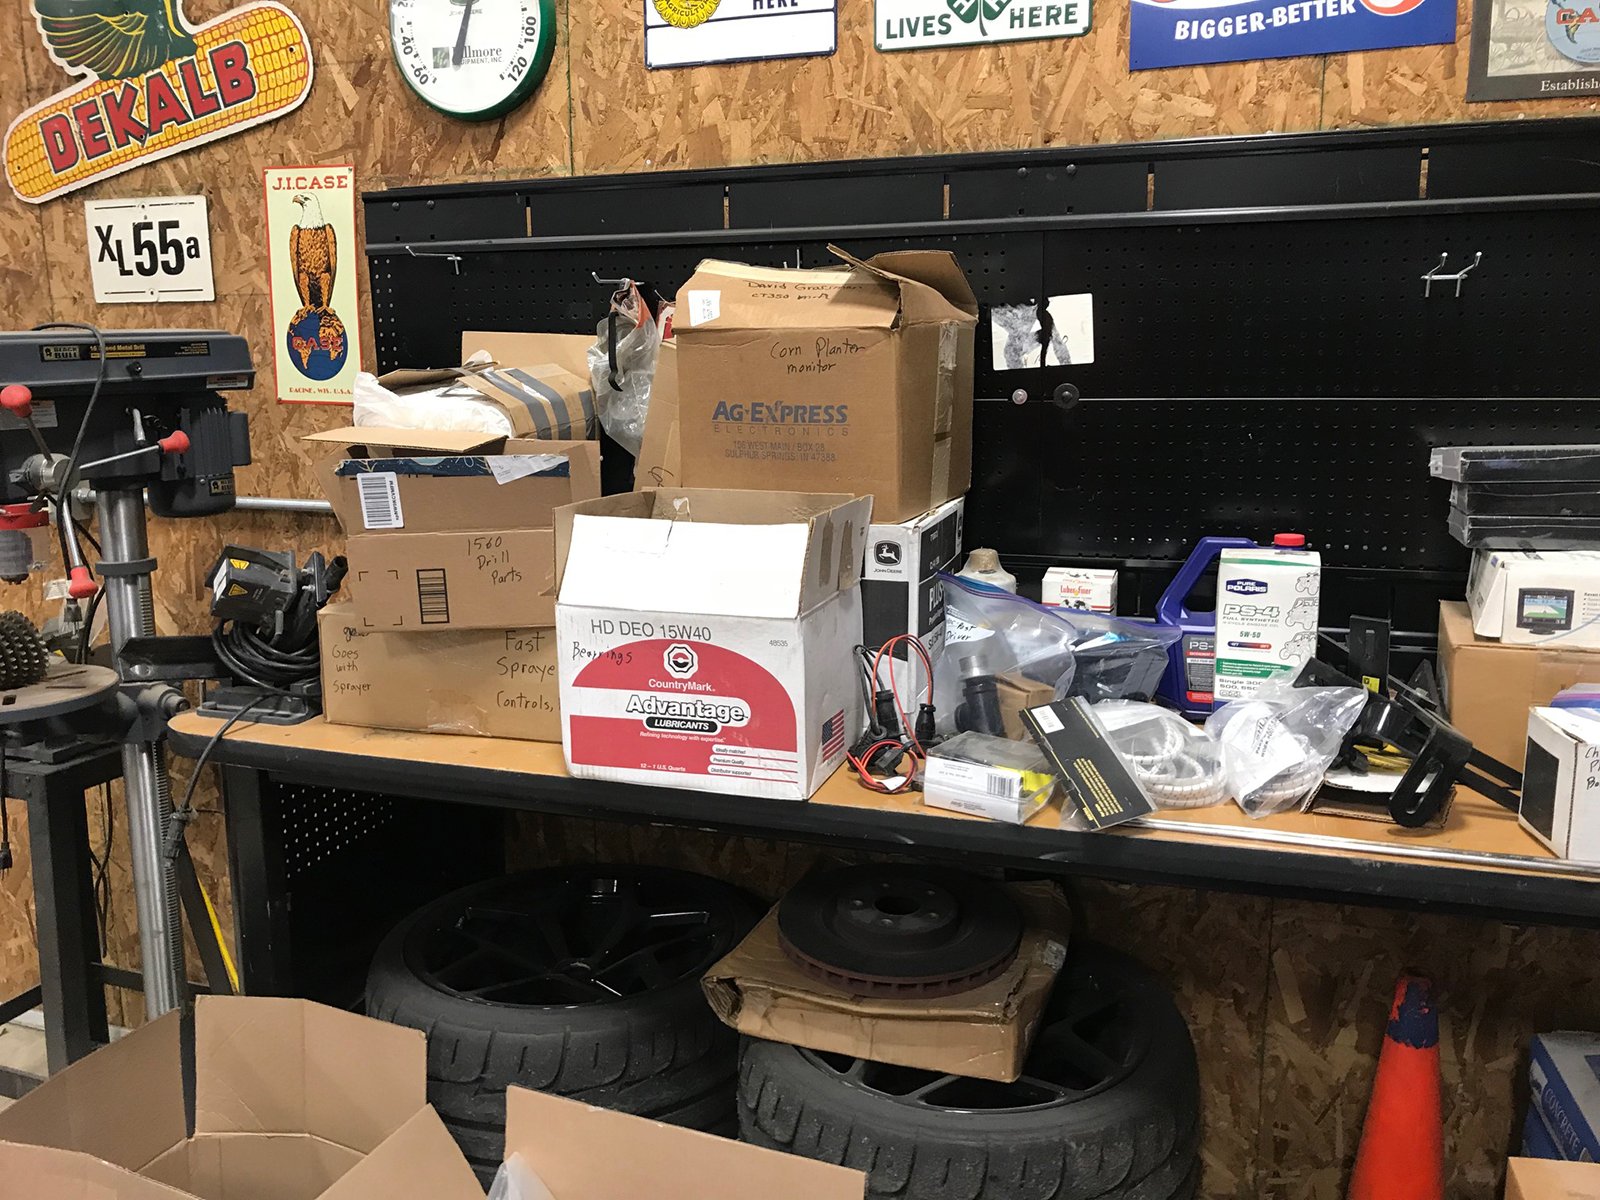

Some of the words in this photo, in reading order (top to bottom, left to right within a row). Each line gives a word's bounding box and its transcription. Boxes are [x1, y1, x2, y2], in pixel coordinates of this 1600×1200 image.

[886, 13, 952, 39] LIVES
[1009, 3, 1078, 29] HERE
[1174, 0, 1356, 40] BIGGER-BETTER
[524, 16, 537, 43] 100
[452, 45, 502, 59] llmore
[507, 56, 528, 82] 120
[39, 40, 257, 175] DEKALB
[770, 341, 802, 359] Corn
[815, 336, 866, 358] Planter
[786, 359, 837, 374] monitor
[714, 424, 849, 437] ELECTRONICS
[748, 441, 769, 451] WEST
[467, 535, 503, 556] 1560
[477, 549, 510, 569] Drill
[491, 568, 522, 585] Parts
[1227, 584, 1267, 592] POLARIS
[1223, 604, 1281, 618] PS-4
[591, 619, 615, 635] HD
[620, 621, 654, 638] DEO
[660, 624, 712, 641] 15W40
[505, 629, 546, 652] Fast
[1189, 641, 1214, 650] PS-
[332, 644, 359, 660] Goes
[336, 660, 359, 672] with
[496, 656, 556, 683] Spraye
[332, 680, 371, 696] Sprayer
[496, 691, 555, 713] Controls,
[626, 694, 746, 724] Advantage
[654, 718, 710, 730] LUBRICANTS
[639, 731, 661, 739] Refining
[661, 733, 688, 741] technology
